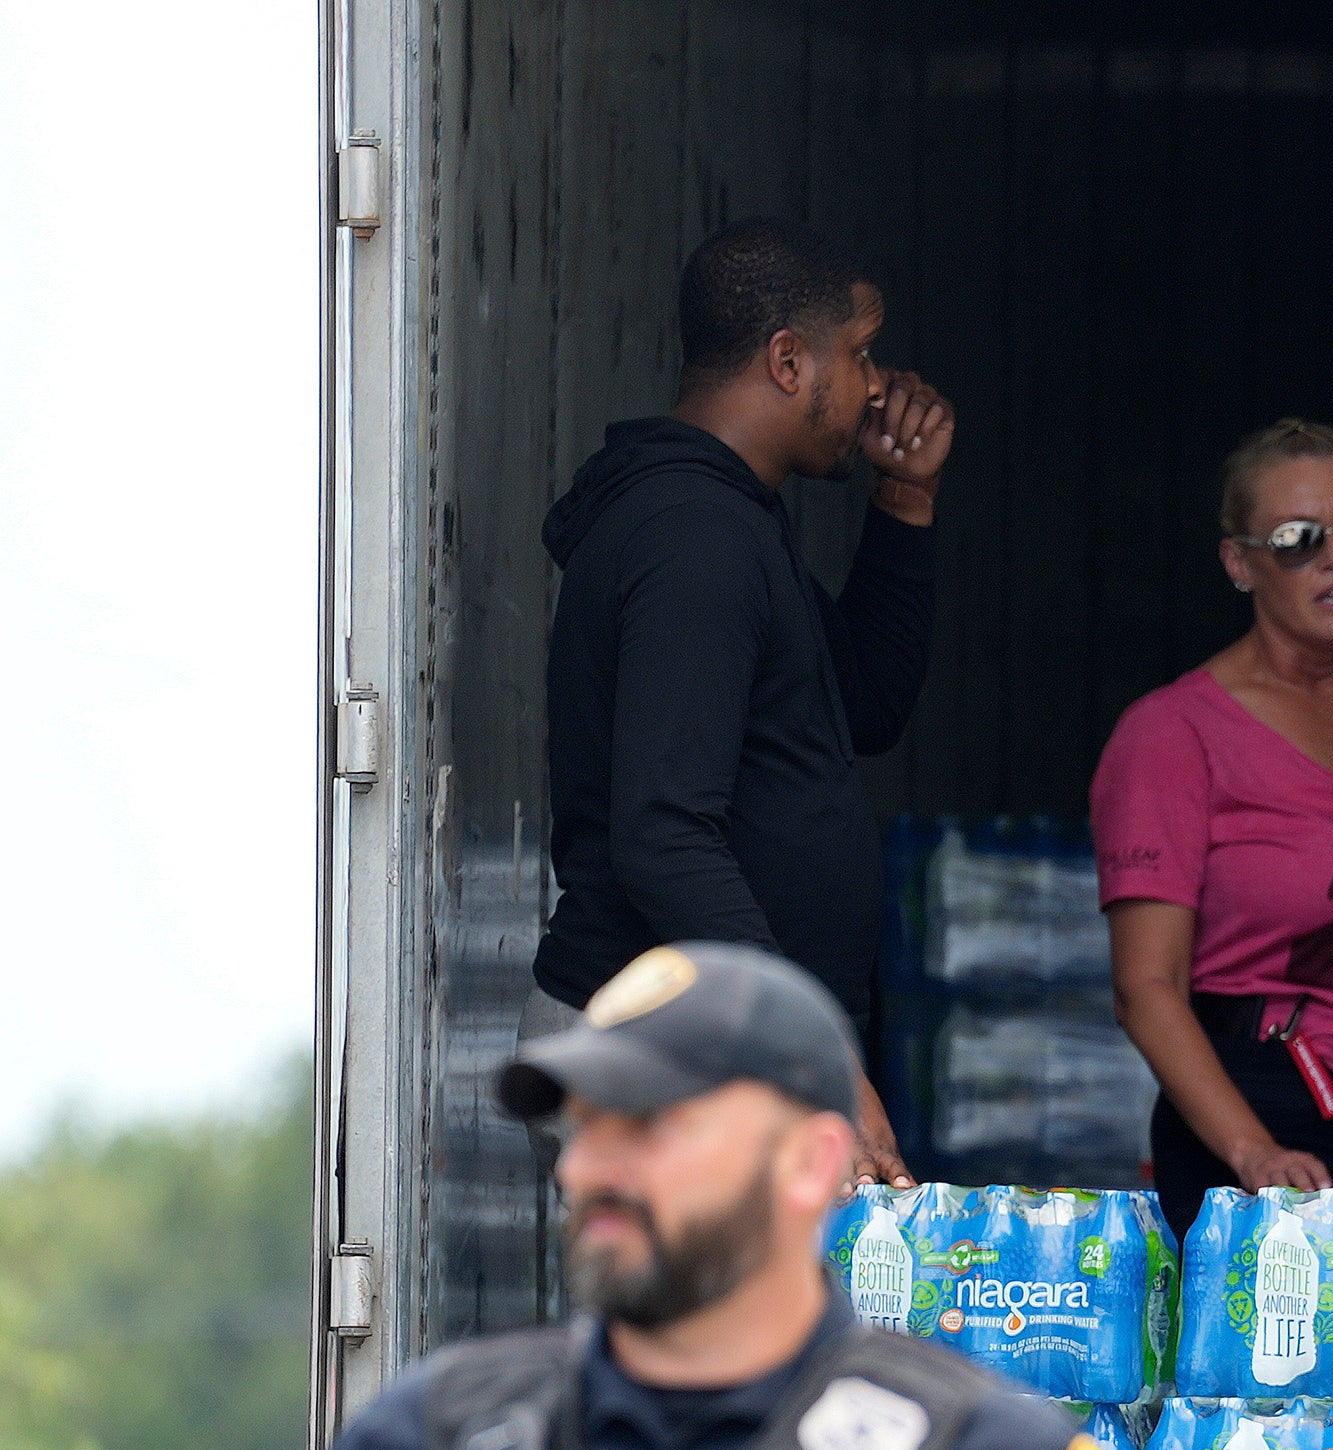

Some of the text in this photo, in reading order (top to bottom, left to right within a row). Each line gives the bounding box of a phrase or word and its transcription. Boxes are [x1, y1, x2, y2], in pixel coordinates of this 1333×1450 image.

[858, 1238, 906, 1263] GIVE THIS
[1084, 1244, 1104, 1260] 24
[1263, 1239, 1311, 1267] GIVE THIS
[858, 1262, 905, 1292] BOTTLE
[1263, 1263, 1311, 1296] BOTTLE
[858, 1293, 902, 1314] ANOTHER
[957, 1274, 1089, 1336] niagara
[1262, 1295, 1308, 1316] ANOTHER
[965, 1315, 1099, 1329] PURIFIED DRINKING WATER
[1262, 1319, 1306, 1357] LIFE
